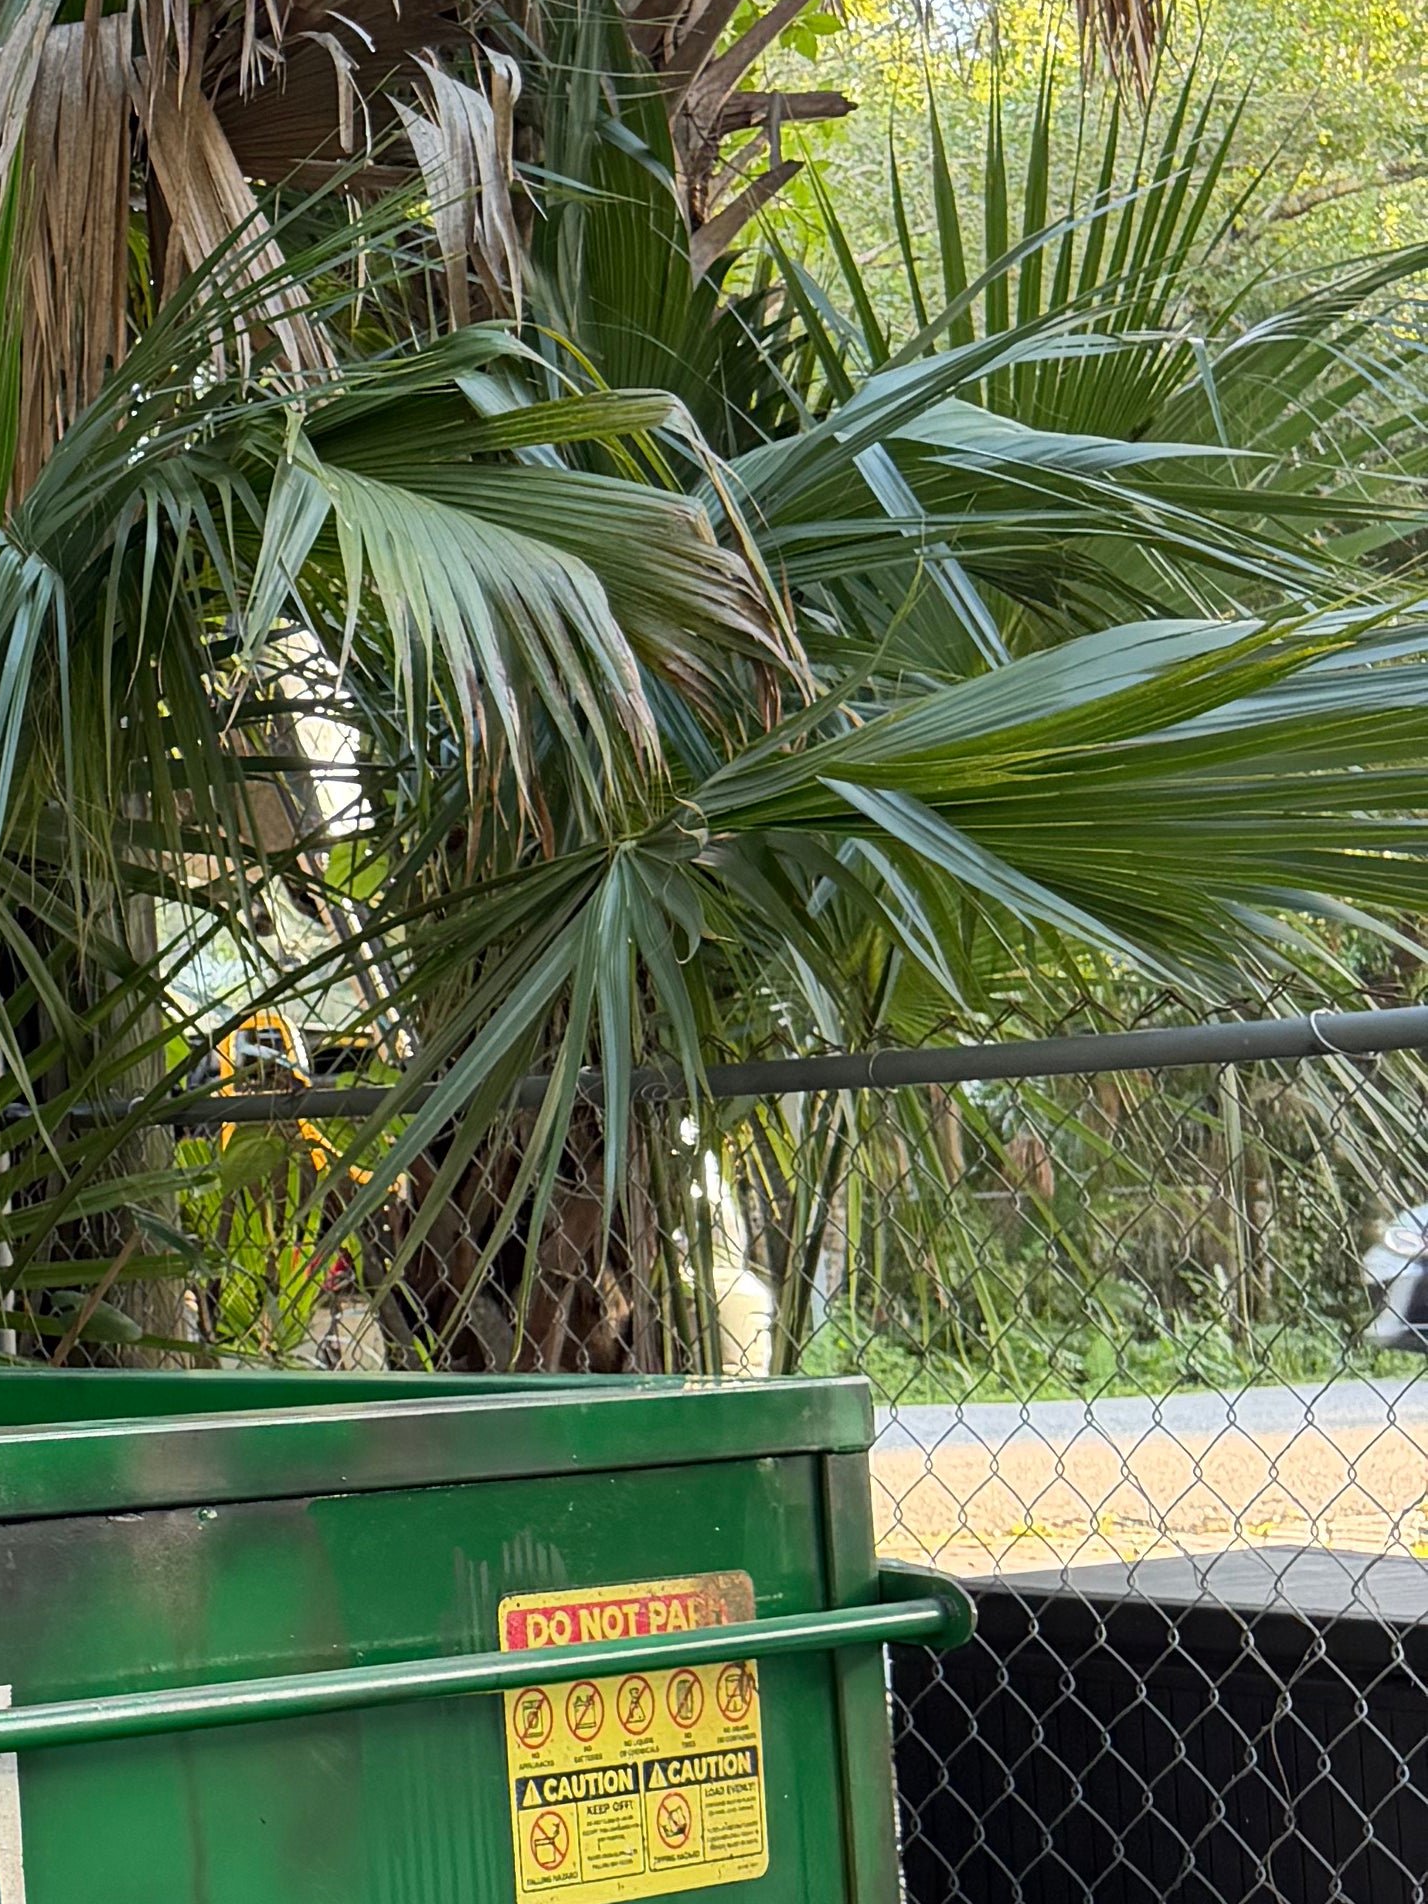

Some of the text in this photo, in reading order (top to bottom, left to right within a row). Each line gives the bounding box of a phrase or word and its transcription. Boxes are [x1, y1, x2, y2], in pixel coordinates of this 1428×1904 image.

[525, 1610, 572, 1648] DO
[578, 1602, 641, 1642] NOT
[667, 1751, 752, 1784] CAUTION
[543, 1768, 634, 1802] CAUTION
[586, 1803, 610, 1815] KEEP
